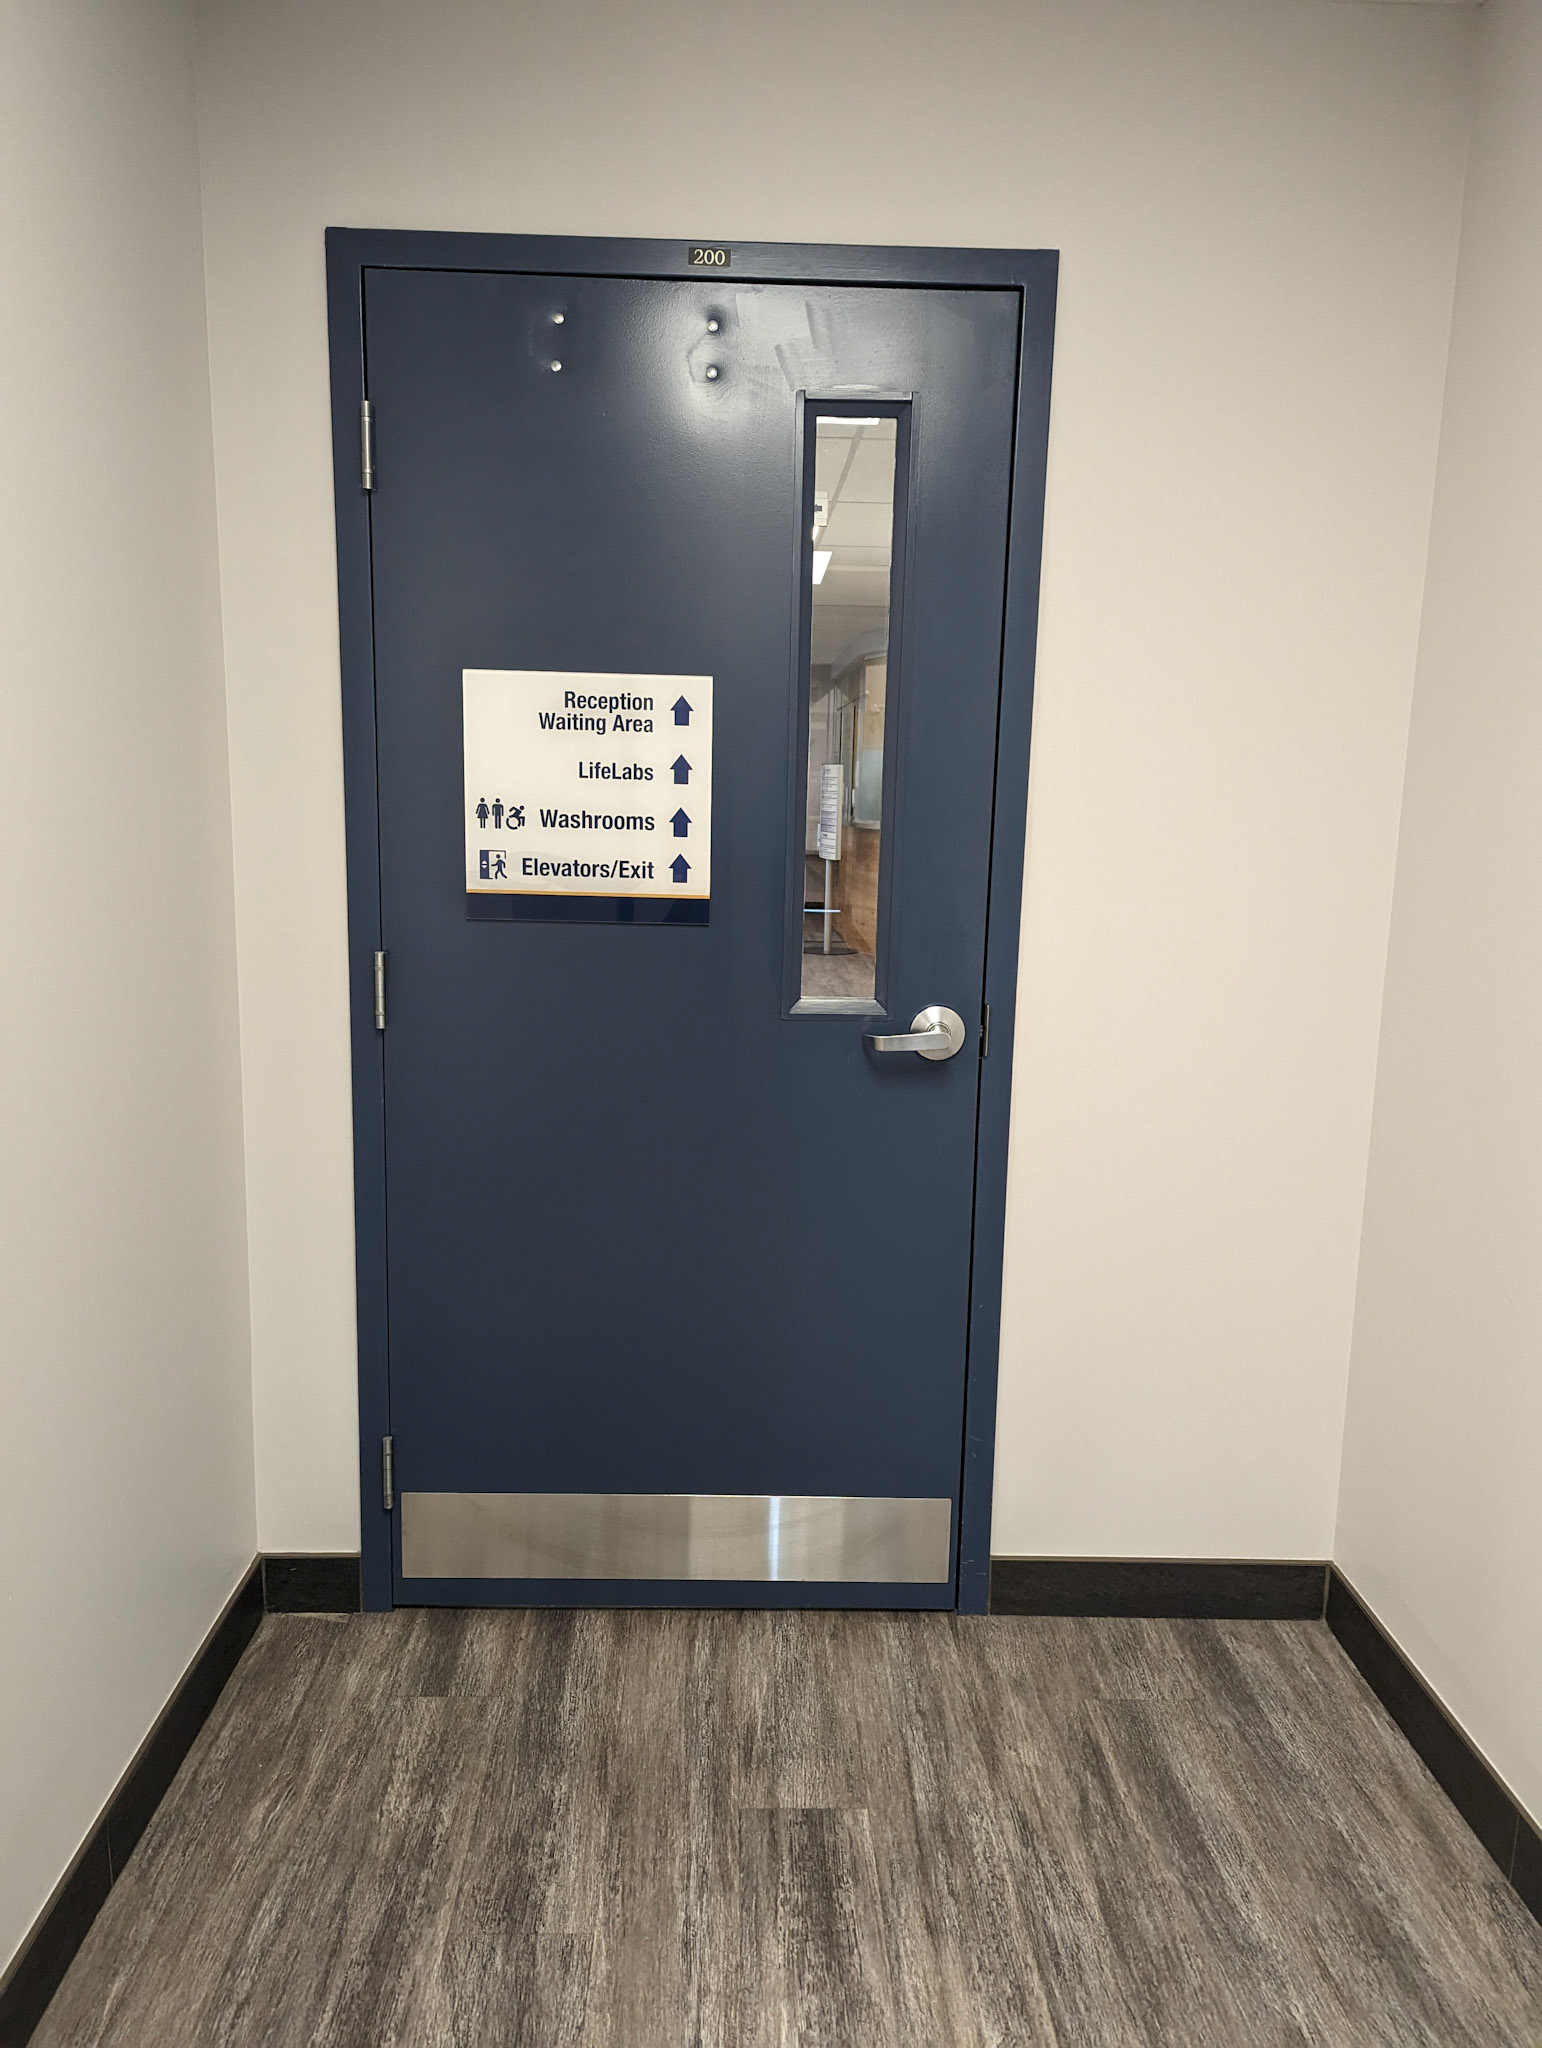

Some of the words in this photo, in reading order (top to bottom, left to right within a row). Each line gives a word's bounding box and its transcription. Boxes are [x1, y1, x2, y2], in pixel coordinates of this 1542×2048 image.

[693, 248, 726, 266] 200
[564, 691, 654, 714] Reception
[538, 712, 607, 735] Waiting
[612, 714, 654, 733] Area
[578, 761, 654, 781] LifeLabs
[540, 809, 655, 831] Washrooms
[522, 857, 655, 879] Elevators/Exit
